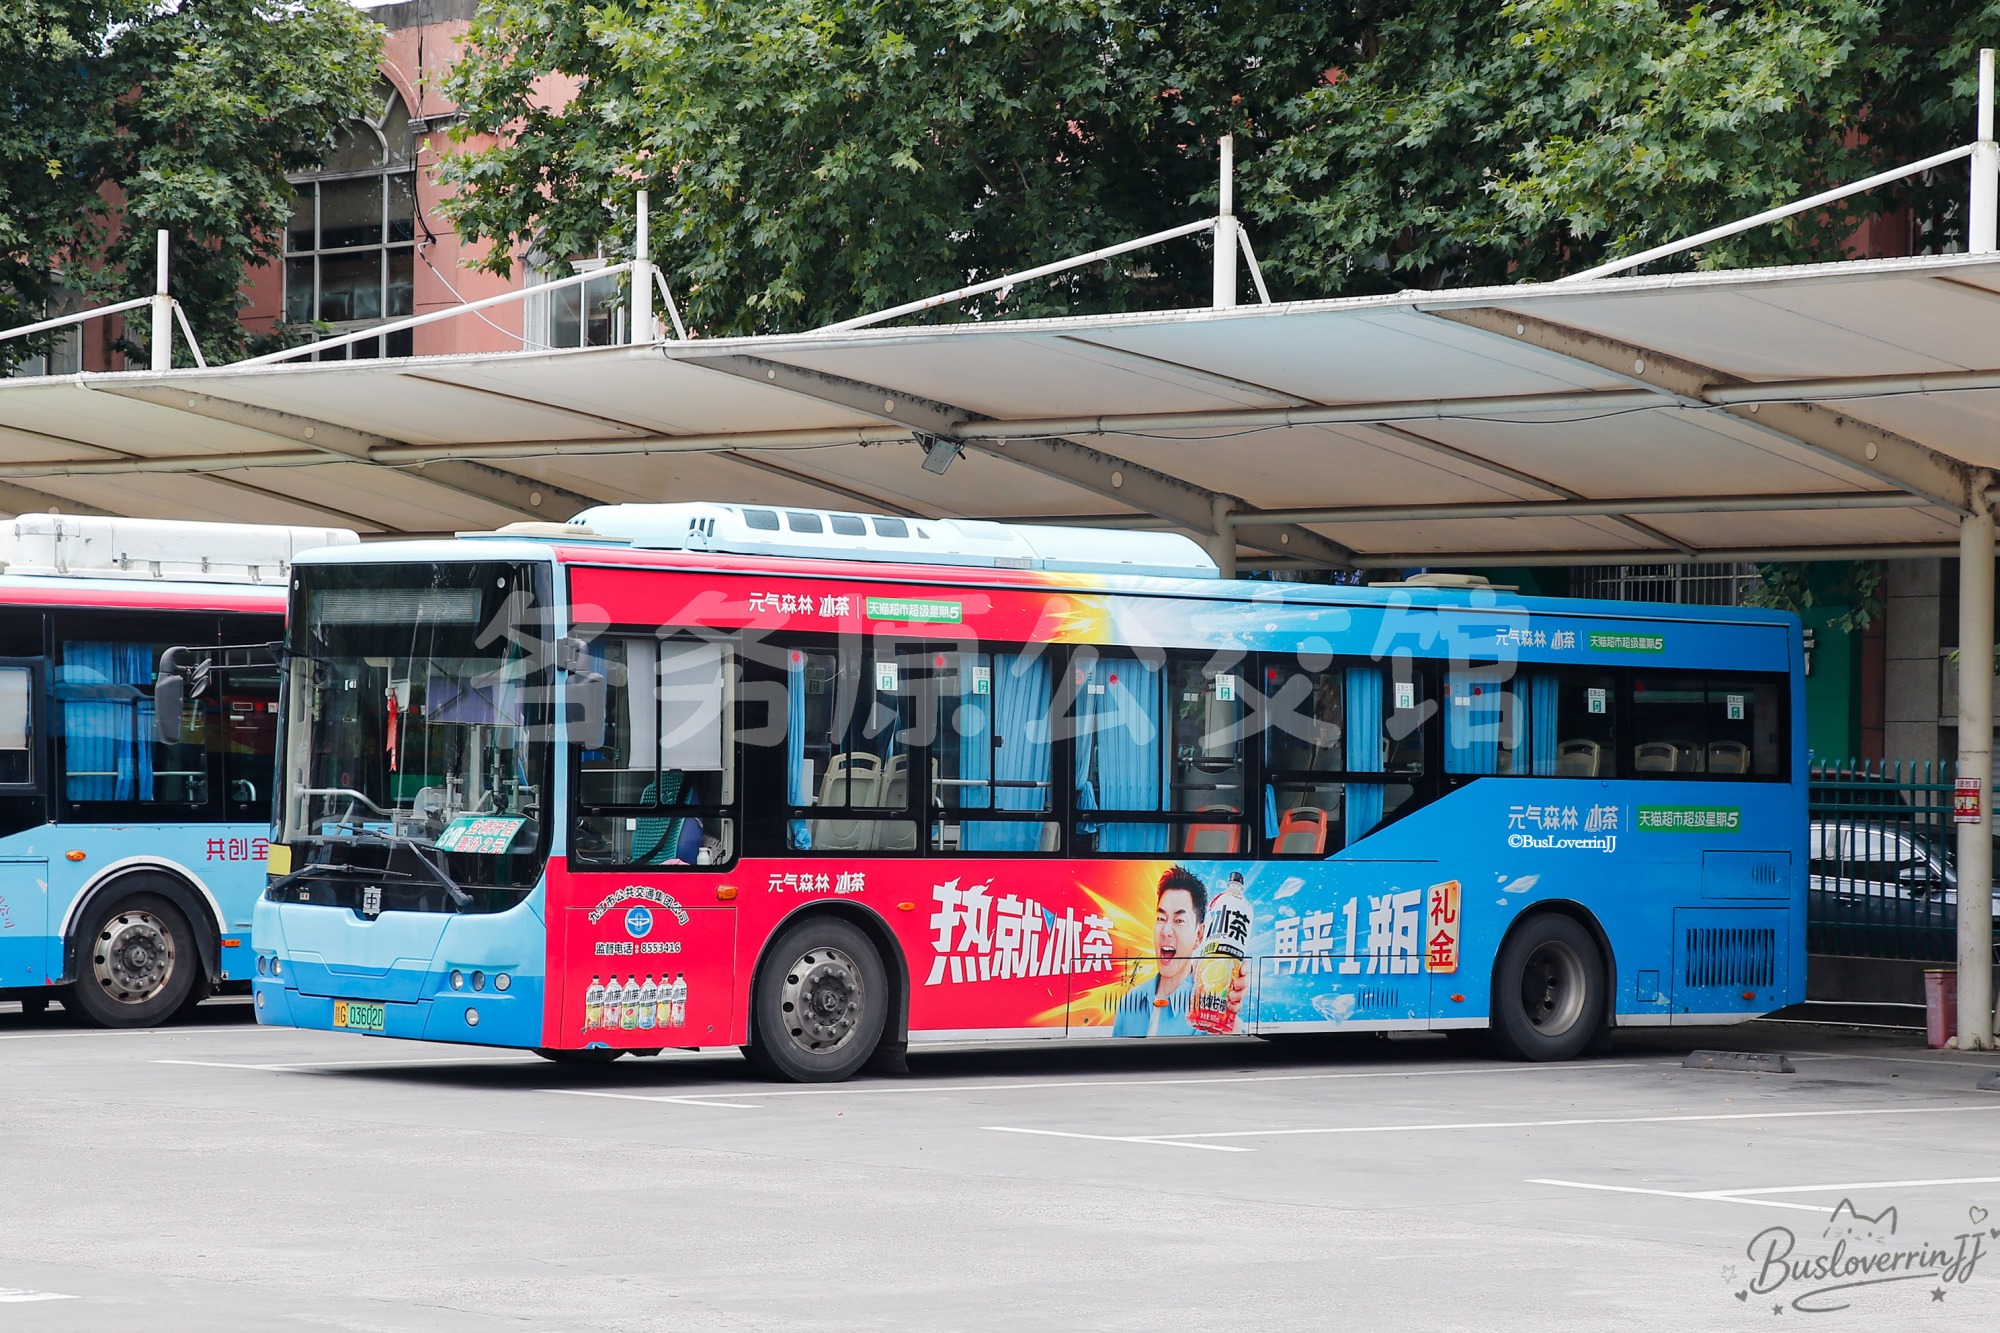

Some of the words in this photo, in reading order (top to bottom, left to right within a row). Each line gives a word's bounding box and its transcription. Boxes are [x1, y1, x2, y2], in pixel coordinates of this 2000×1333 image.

[749, 592, 814, 615] 元气森林
[818, 593, 850, 618] 冰茶
[868, 601, 960, 619] 天猫超市超级星期5
[1495, 628, 1547, 648] 元气森林
[1551, 629, 1576, 650] 冰茶
[1590, 635, 1663, 650] 天猫超市超级星期5
[1508, 805, 1579, 830] 元气森林
[1584, 804, 1619, 832] 冰茶
[1639, 811, 1739, 828] 天猫超市超级星期5
[207, 838, 268, 860] 共创全
[768, 873, 830, 893] 元气森林
[834, 871, 865, 894] 冰茶
[588, 886, 689, 925] 九江市公共交通集团公司
[924, 876, 1114, 986] 热就冰茶
[1206, 904, 1250, 946] 冰茶
[1273, 889, 1422, 975] 再来1瓶
[1429, 888, 1456, 967] 礼金
